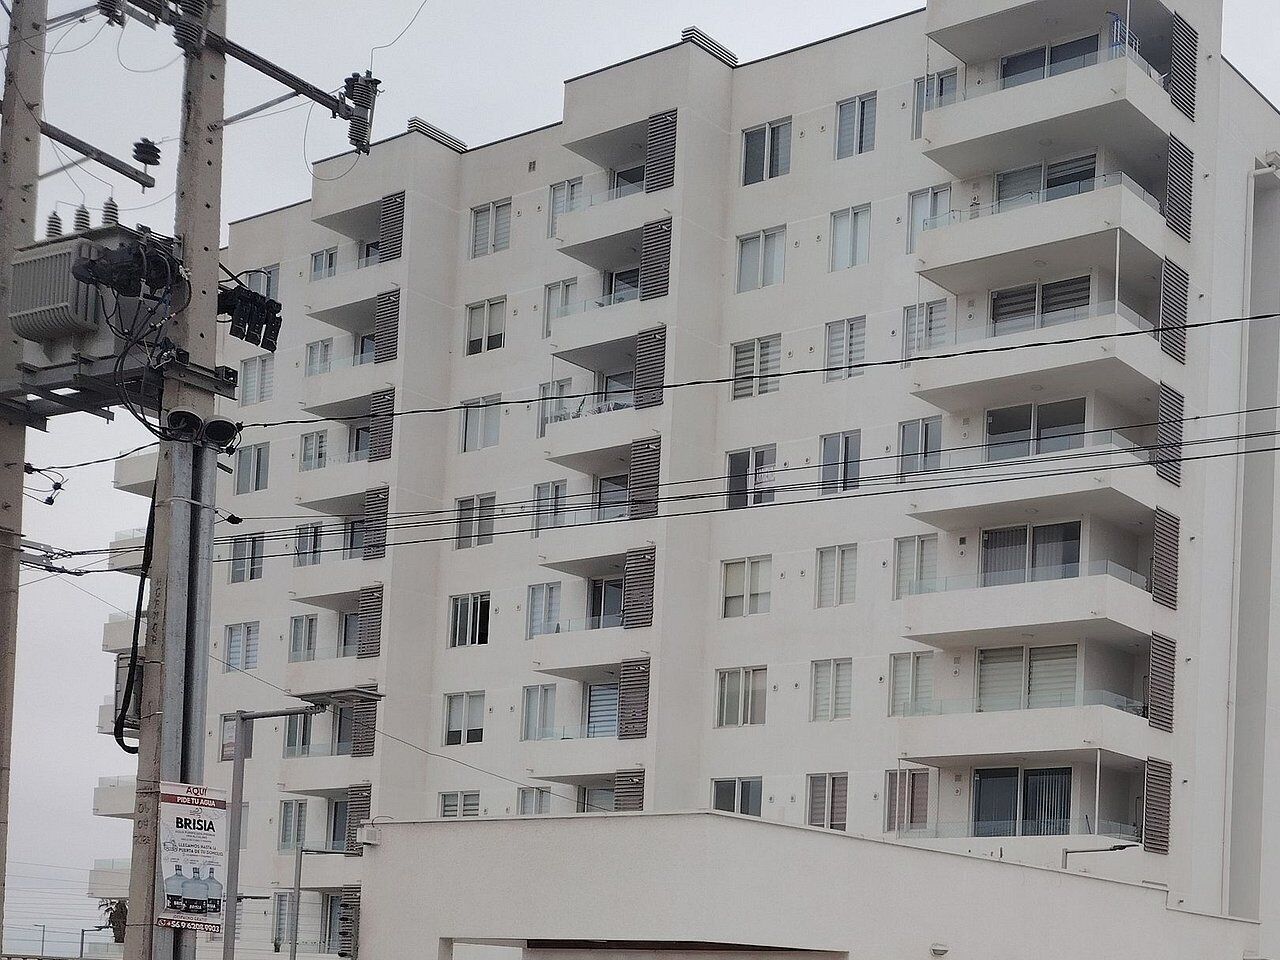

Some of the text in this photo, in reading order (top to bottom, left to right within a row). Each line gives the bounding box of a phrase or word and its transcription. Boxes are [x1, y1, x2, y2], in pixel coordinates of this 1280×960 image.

[186, 786, 208, 796] AQUÍ
[200, 798, 216, 806] AGUA
[176, 817, 215, 832] BRISIA
